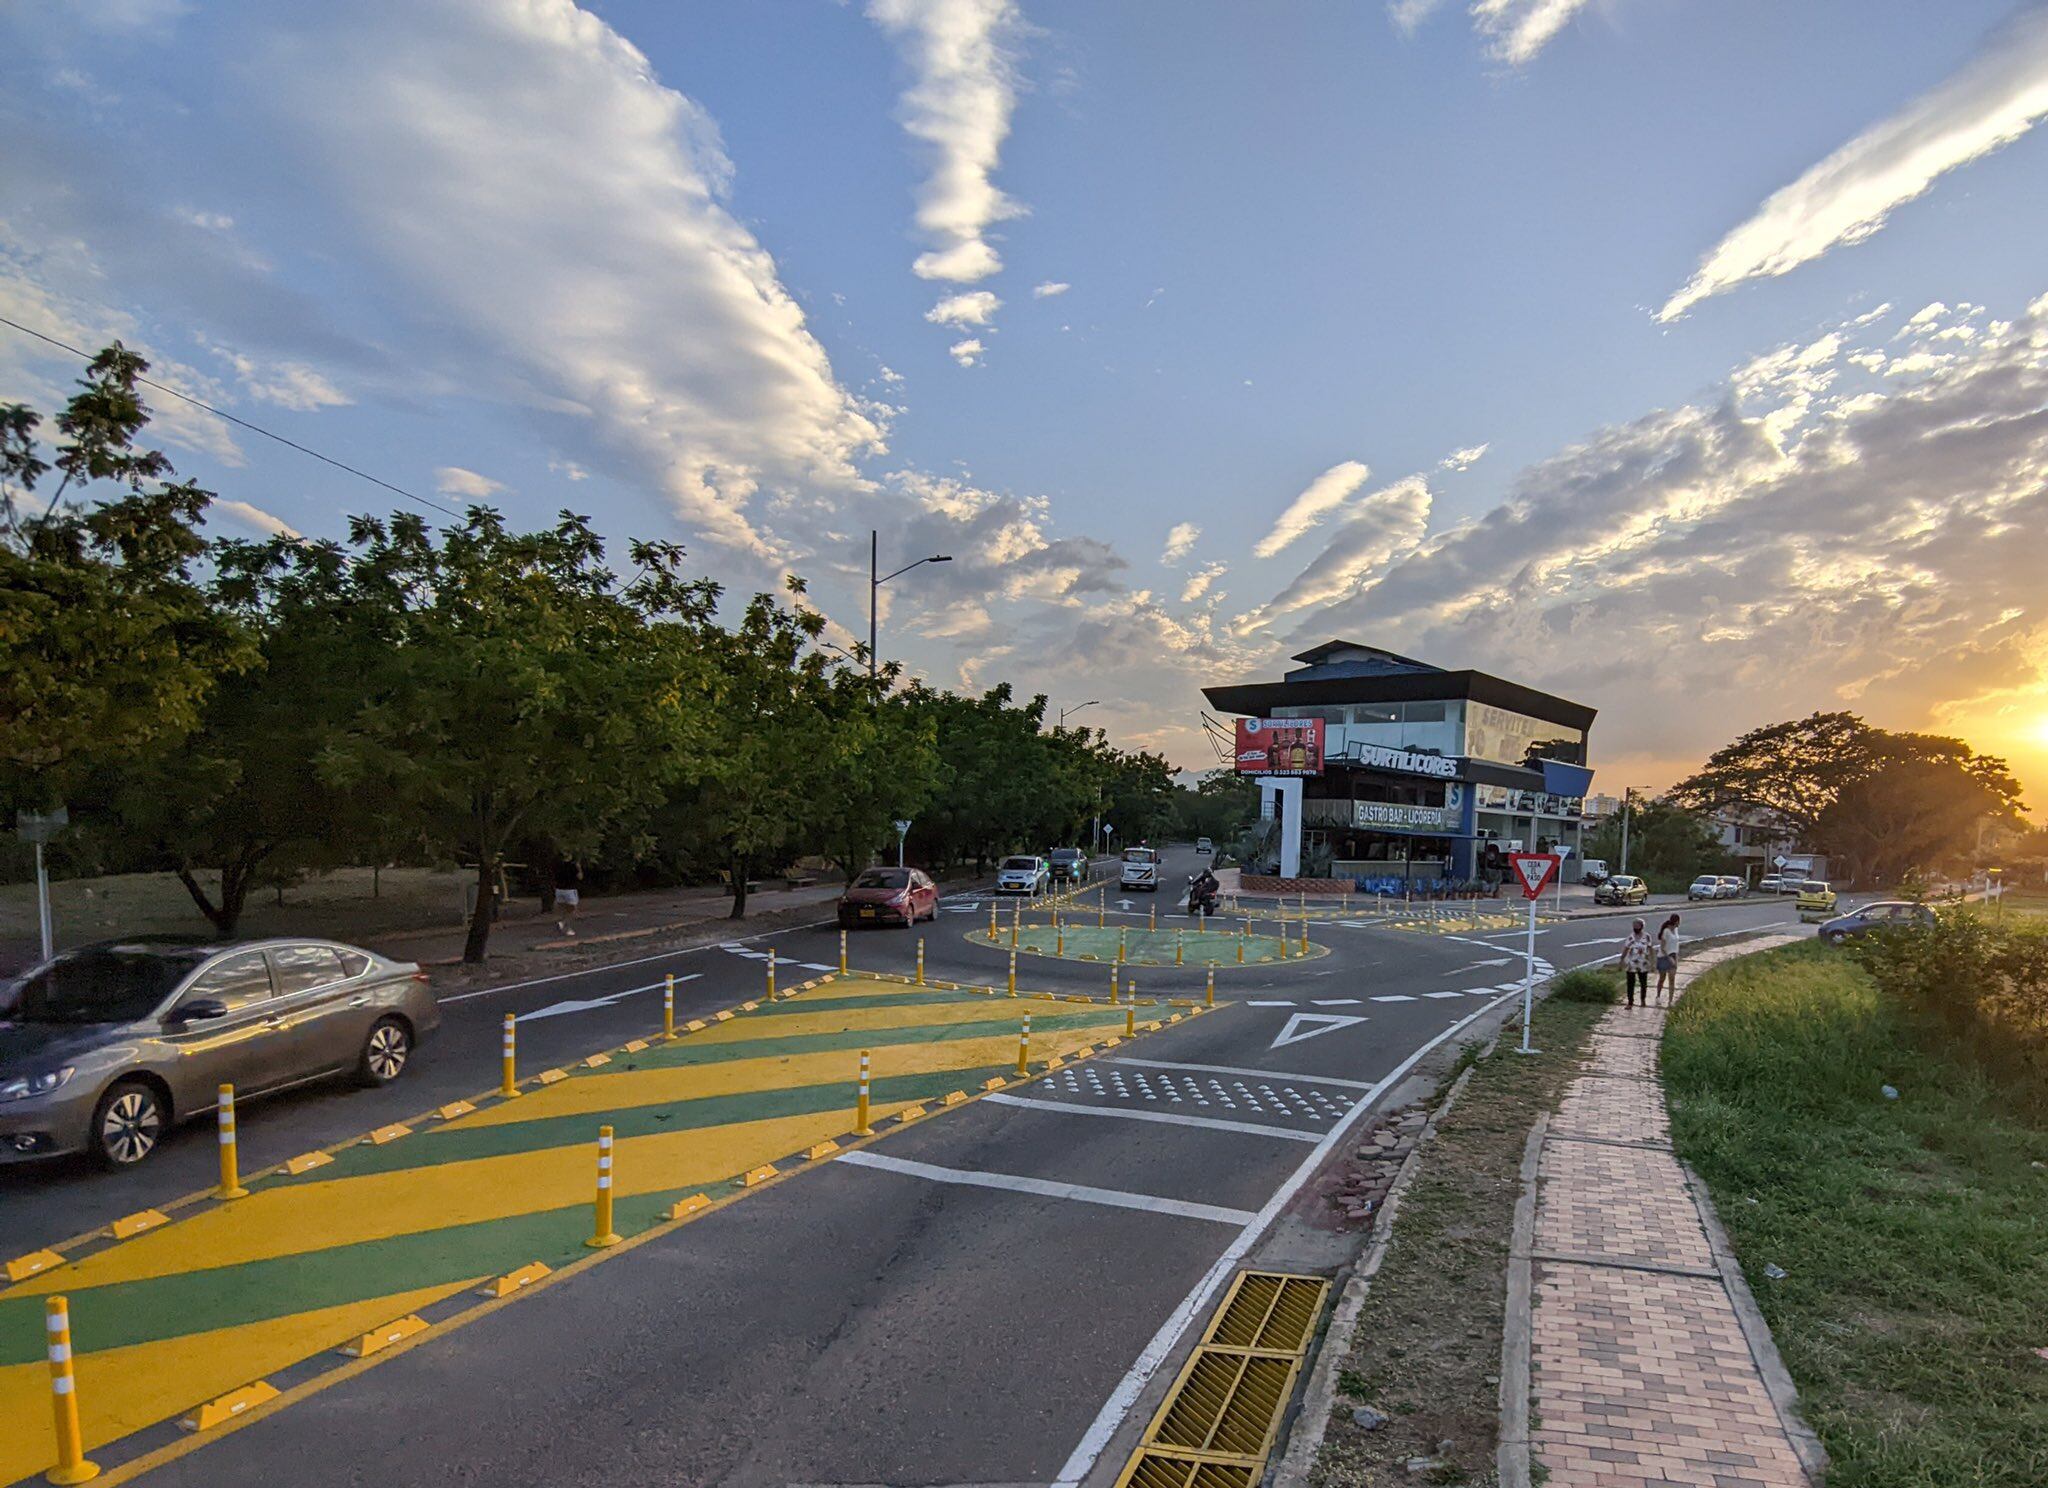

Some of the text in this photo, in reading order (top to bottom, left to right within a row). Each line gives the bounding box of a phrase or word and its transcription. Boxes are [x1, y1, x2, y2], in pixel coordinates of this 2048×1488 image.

[1359, 744, 1458, 777] SURTILICORES
[1358, 805, 1388, 822] GASTRO
[1388, 808, 1403, 823] BAR
